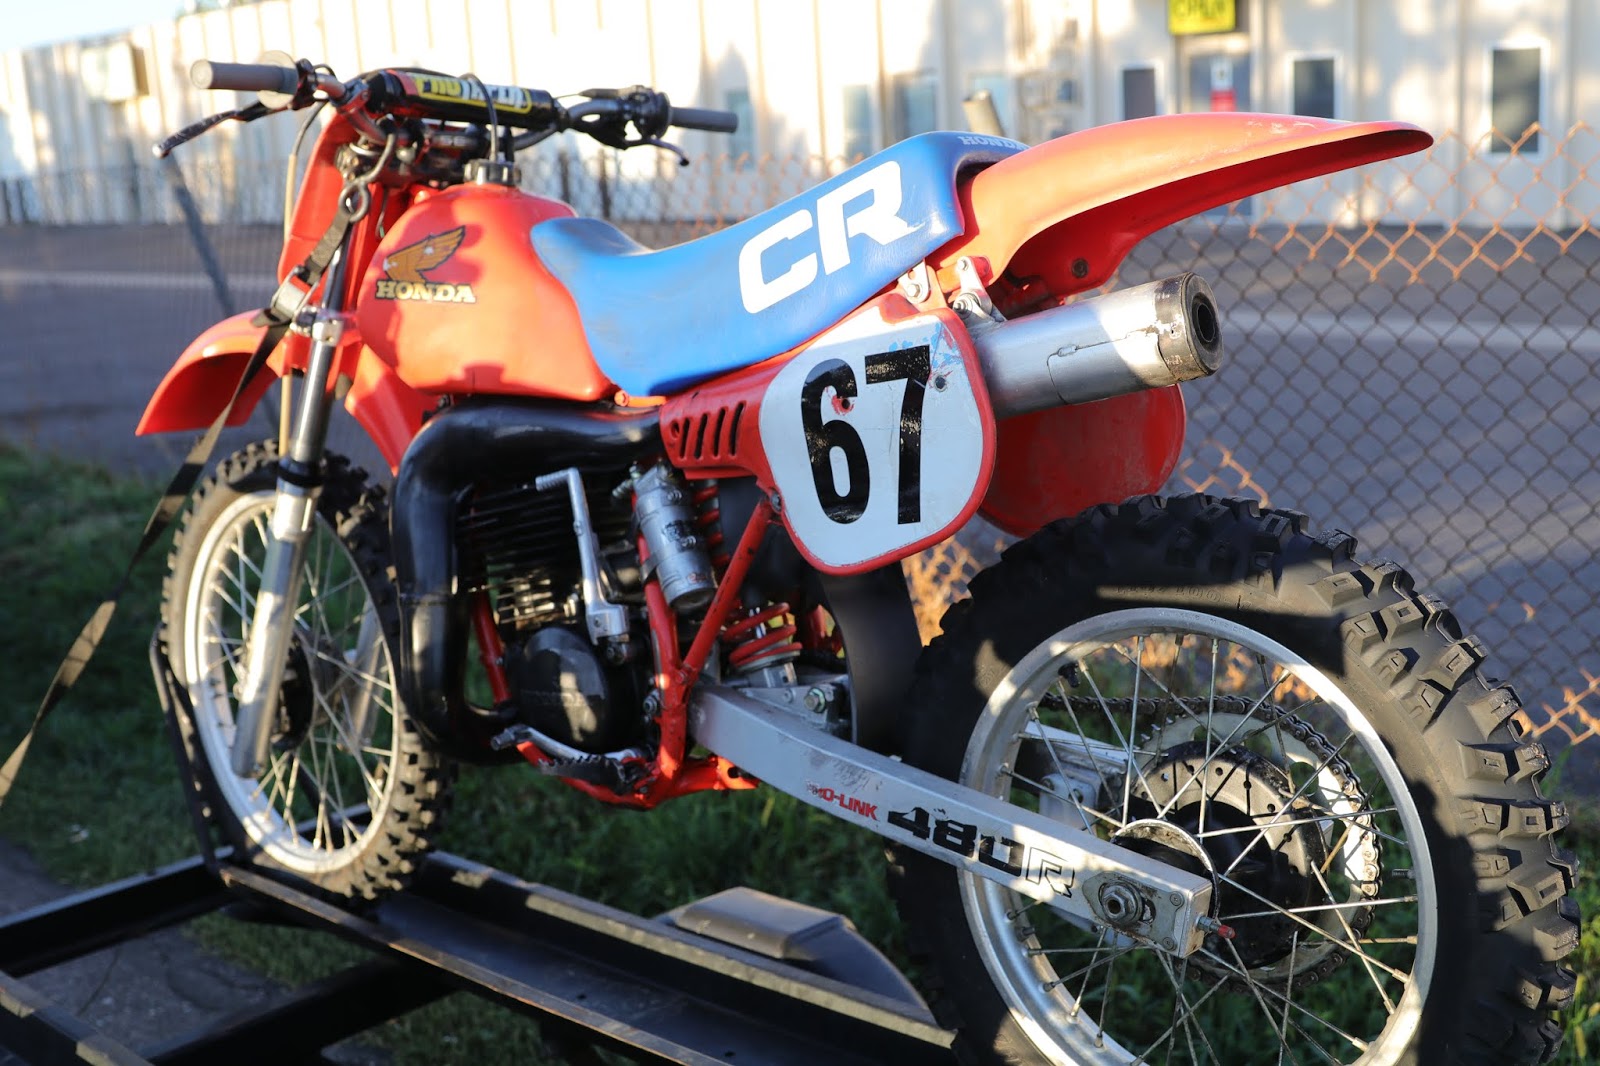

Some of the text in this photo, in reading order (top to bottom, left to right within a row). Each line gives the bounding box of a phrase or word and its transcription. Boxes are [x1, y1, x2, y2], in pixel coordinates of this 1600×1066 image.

[739, 161, 922, 314] CR
[375, 279, 476, 304] HONDA
[801, 344, 930, 525] 67
[807, 784, 879, 821] O-LINK
